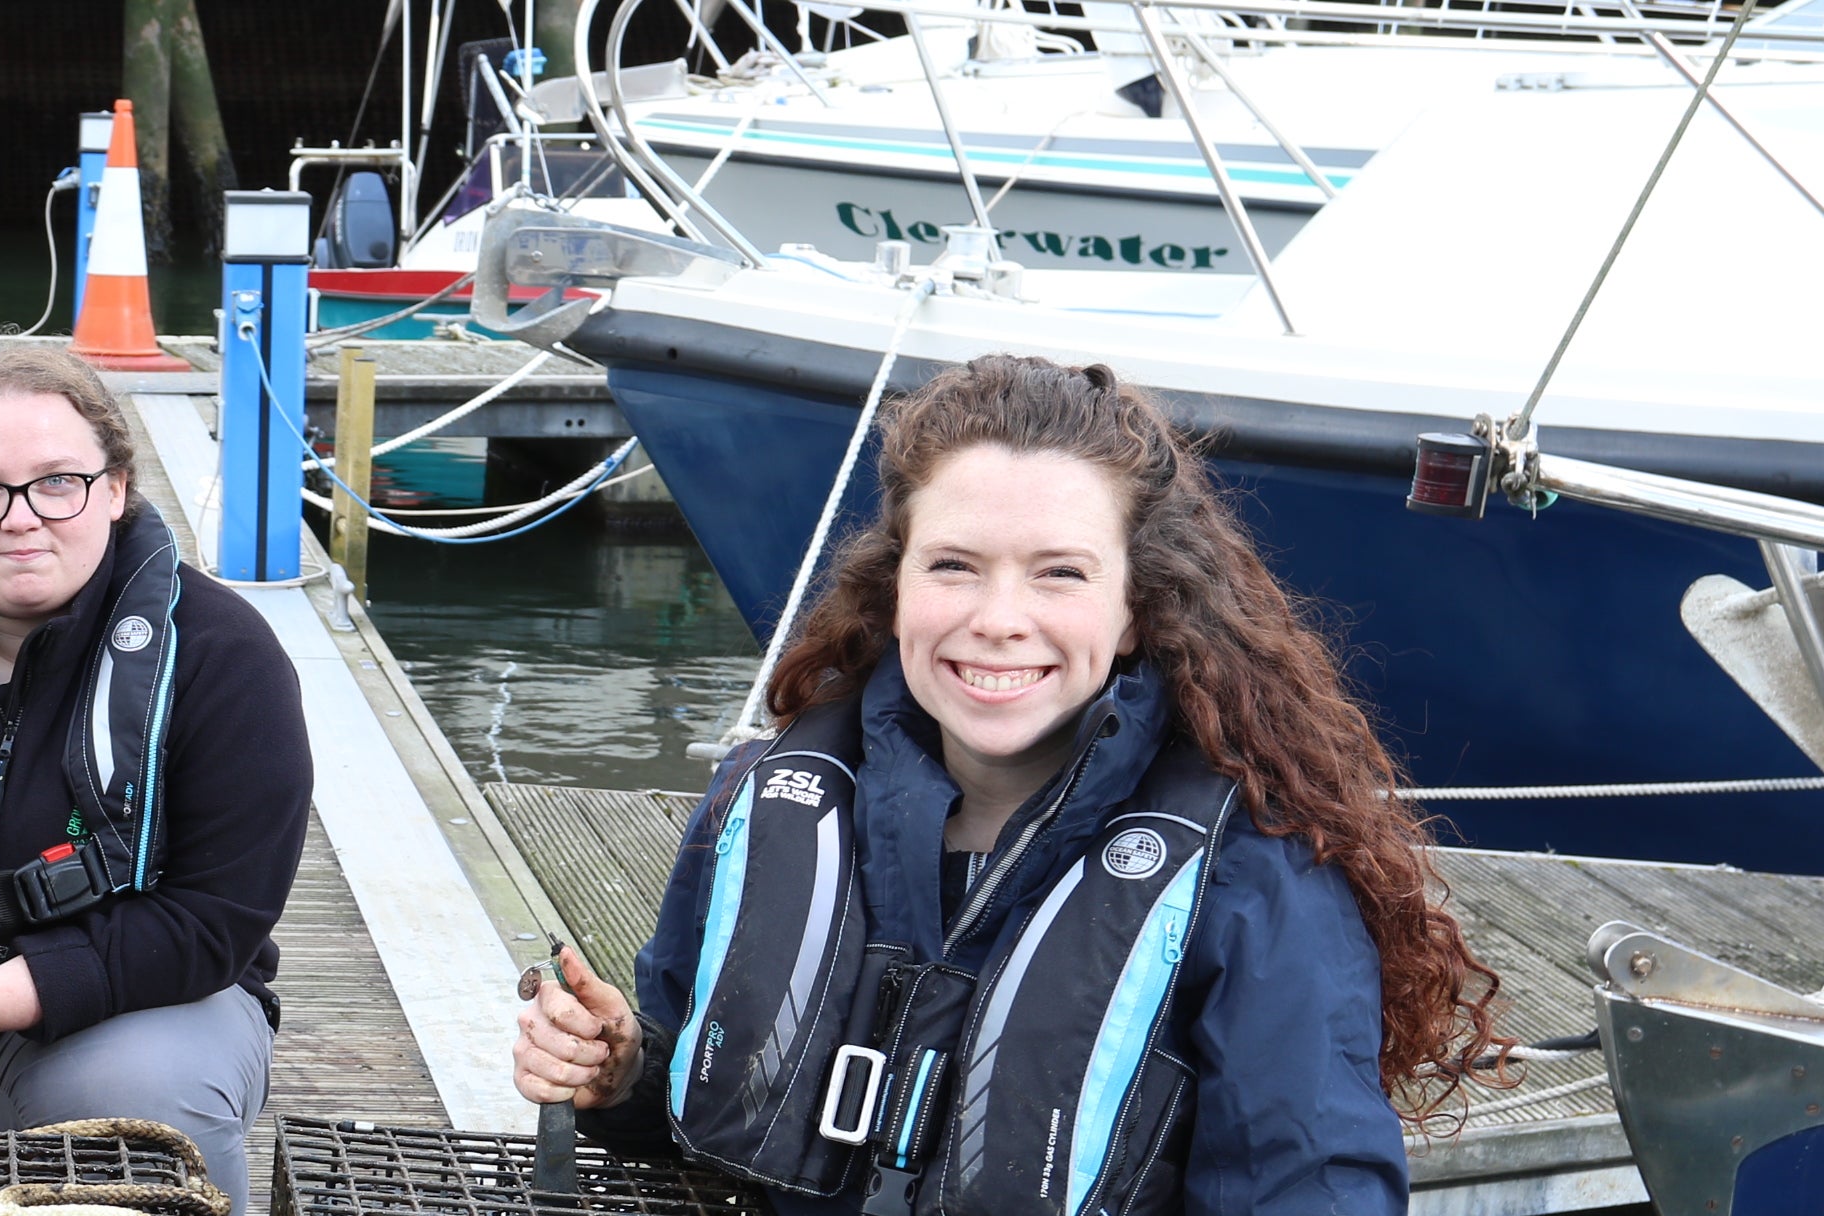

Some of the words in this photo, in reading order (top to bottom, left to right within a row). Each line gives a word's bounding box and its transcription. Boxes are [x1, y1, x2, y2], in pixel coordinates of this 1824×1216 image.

[836, 201, 1229, 269] Clerwater
[762, 785, 791, 794] LET'S
[791, 787, 823, 800] WORK
[767, 769, 825, 795] ZSL
[760, 791, 779, 799] FOR
[779, 791, 821, 807] WILDLIFE
[715, 1027, 725, 1049] ADV
[1048, 1108, 1061, 1146] CYLINDER
[1045, 1145, 1055, 1162] GAS
